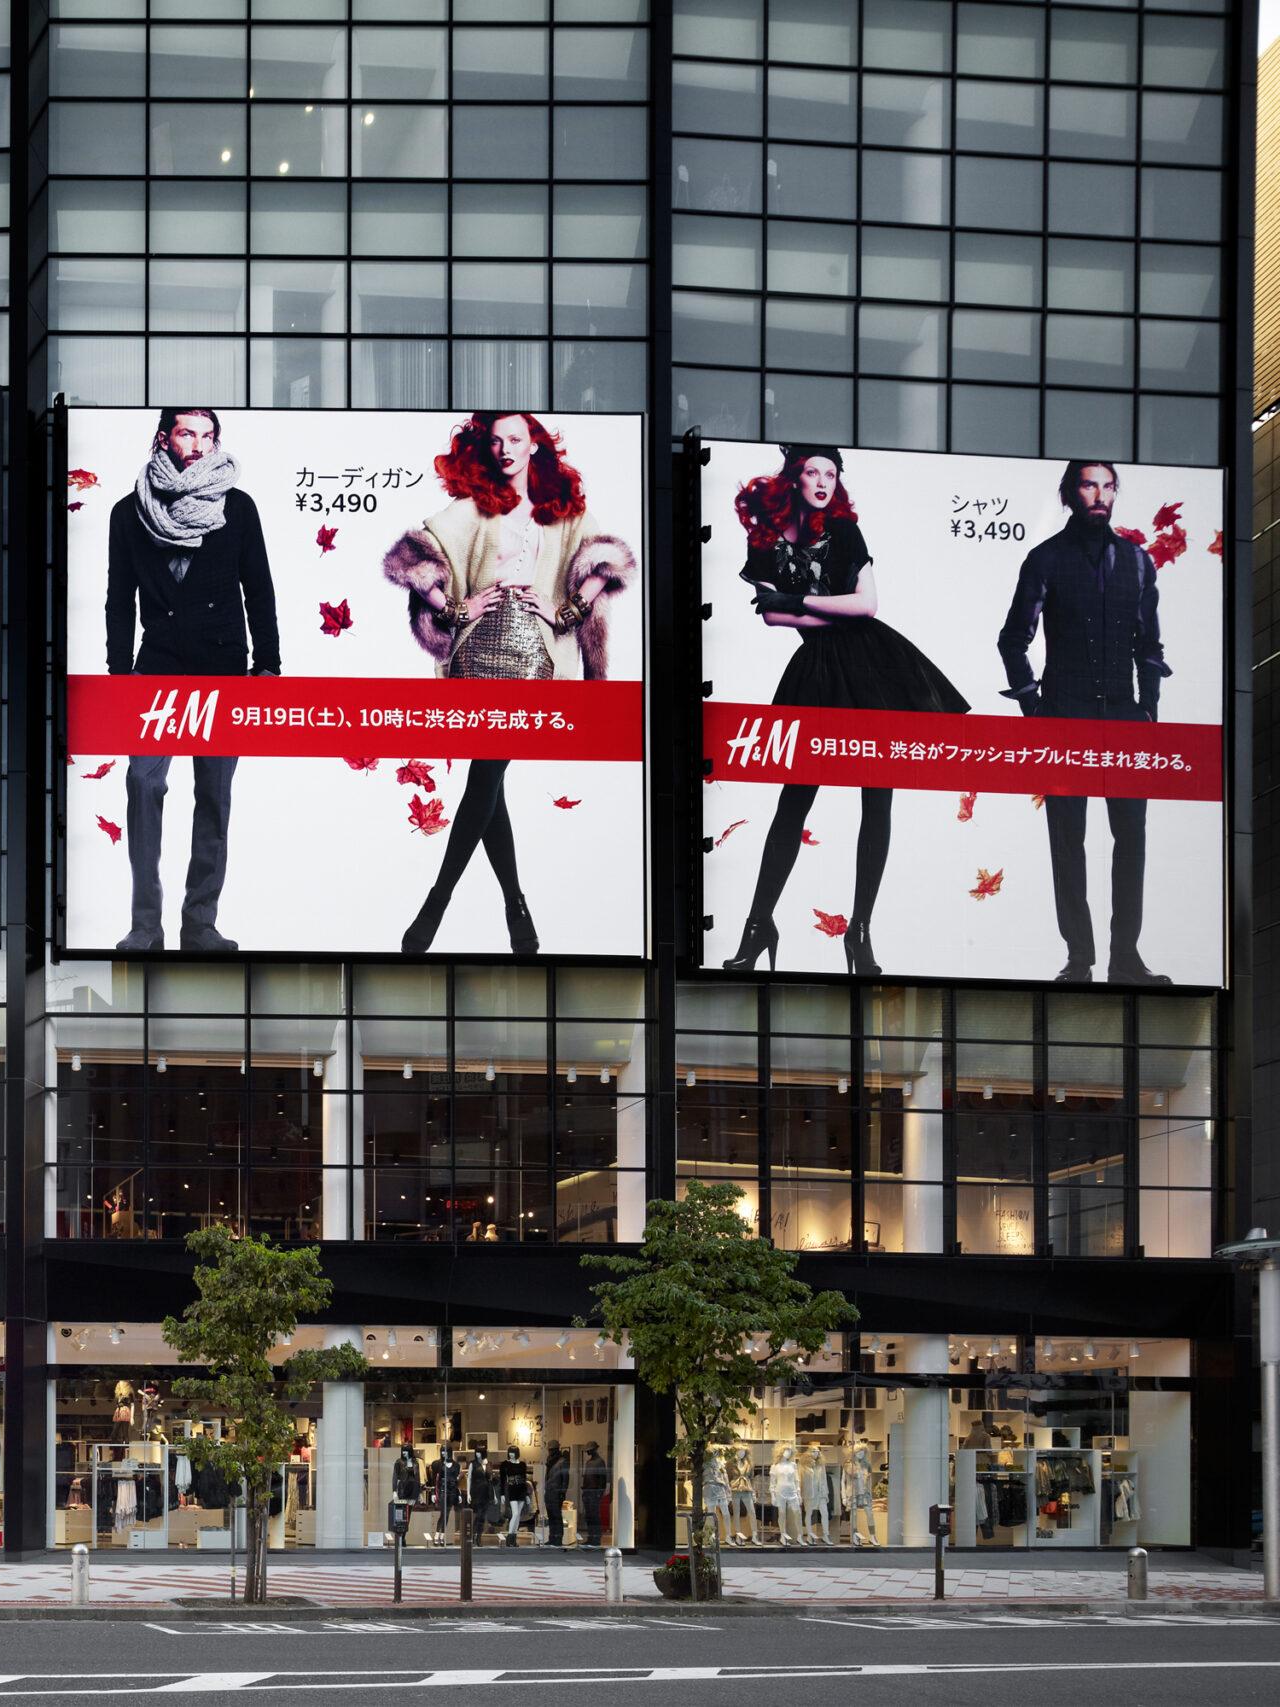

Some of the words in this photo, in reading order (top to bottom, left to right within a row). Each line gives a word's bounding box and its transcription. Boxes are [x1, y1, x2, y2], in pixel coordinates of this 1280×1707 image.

[296, 466, 424, 490] カーディガン
[296, 493, 378, 516] ¥3,490
[951, 494, 1009, 517] シャツ
[950, 520, 1026, 543] ¥3,490
[140, 689, 220, 742] H&M
[726, 717, 801, 770] H&M
[810, 737, 1193, 772] 9月19日、渋谷がファッショナブルに生まれ変わる。
